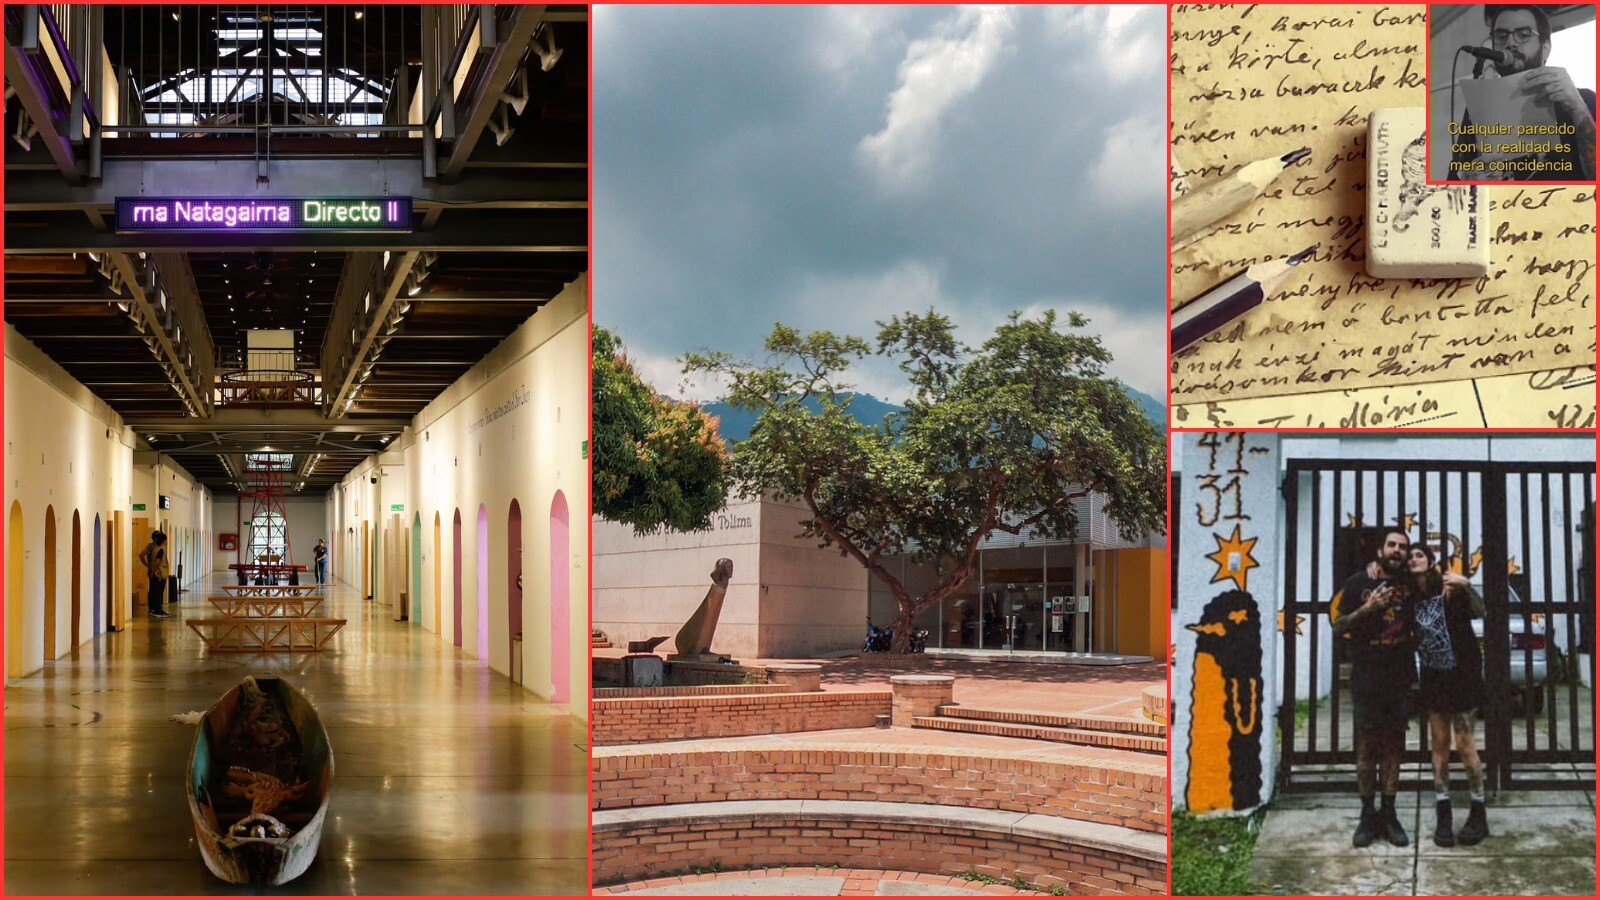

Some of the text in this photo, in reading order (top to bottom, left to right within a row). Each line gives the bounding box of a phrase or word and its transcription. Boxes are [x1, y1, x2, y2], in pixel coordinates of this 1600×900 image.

[134, 206, 168, 222] ma
[175, 201, 290, 227] Natagaima
[304, 201, 381, 222] Directo
[1195, 474, 1251, 527] 31
[718, 513, 753, 530] Tolima
